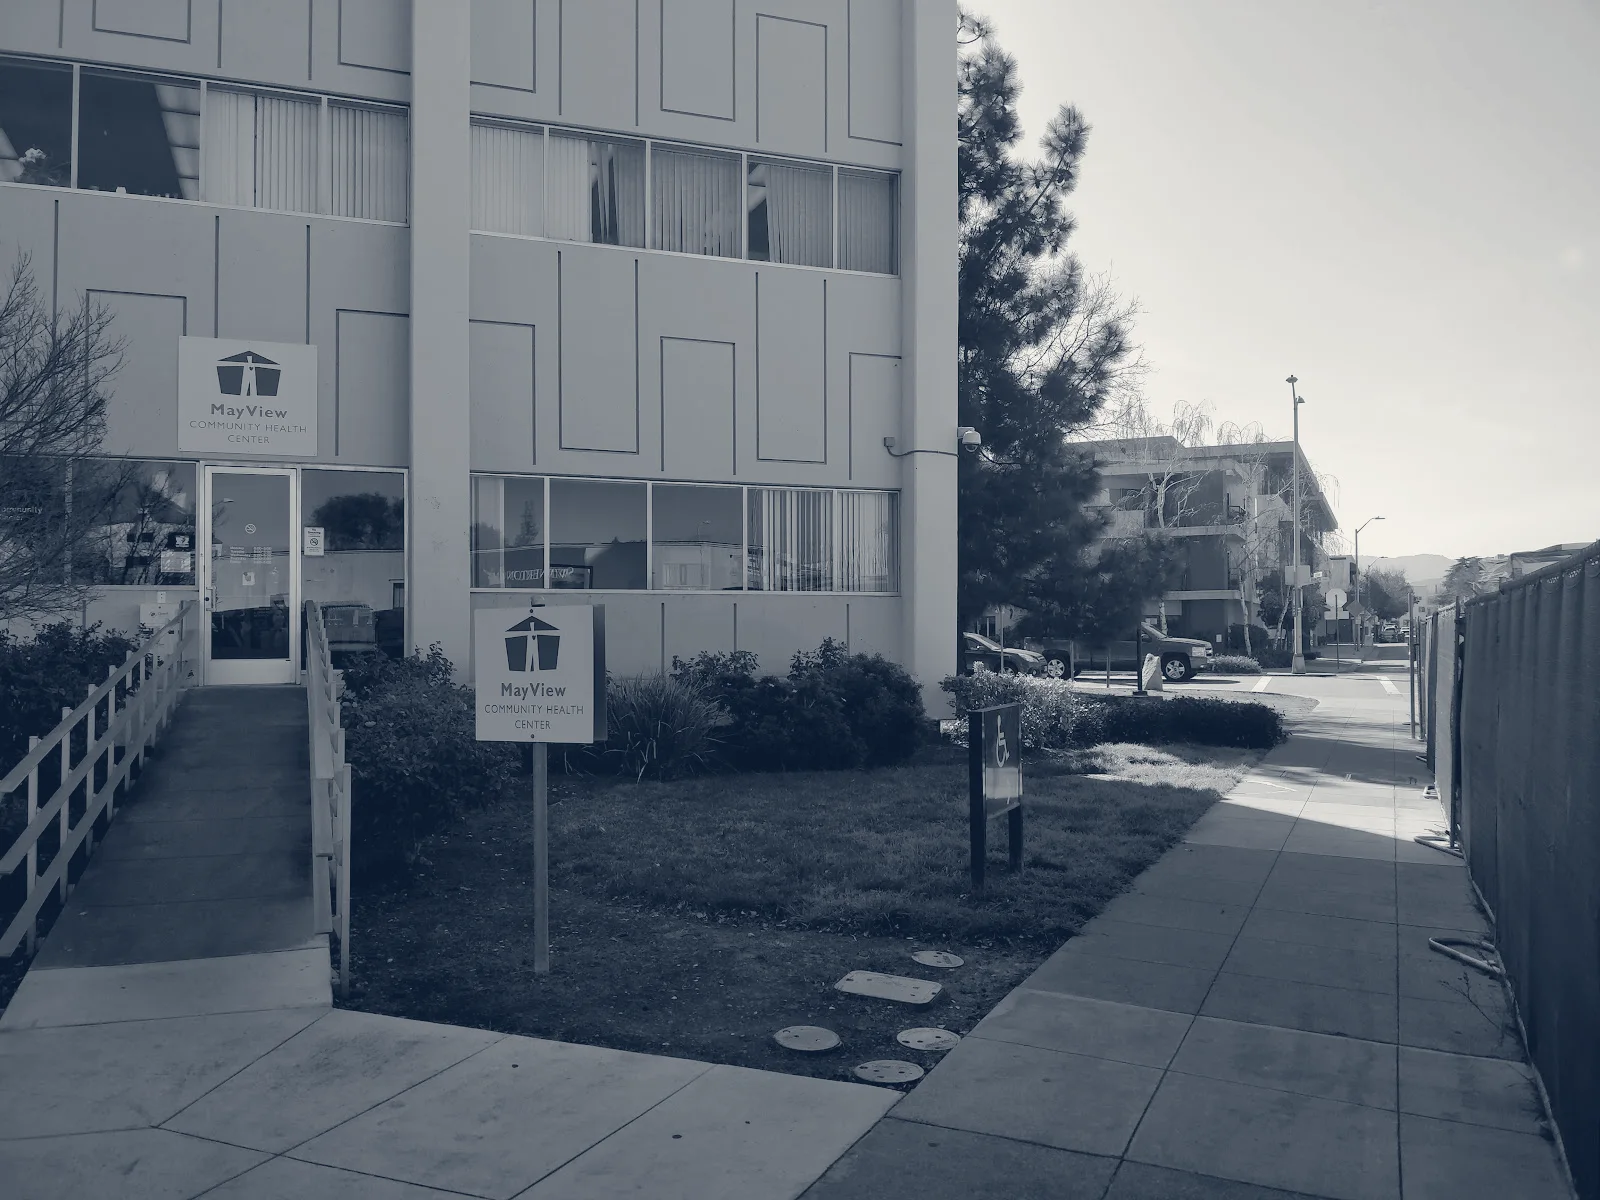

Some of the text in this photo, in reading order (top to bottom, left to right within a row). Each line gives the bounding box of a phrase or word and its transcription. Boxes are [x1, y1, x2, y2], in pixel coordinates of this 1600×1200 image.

[210, 403, 288, 420] MayView
[189, 420, 308, 433] COMMUNITY HEALTH
[227, 434, 270, 444] CENTER
[500, 682, 566, 701] MayView
[484, 704, 584, 715] COMMUNITY HEALTH
[514, 719, 551, 730] CENTER
